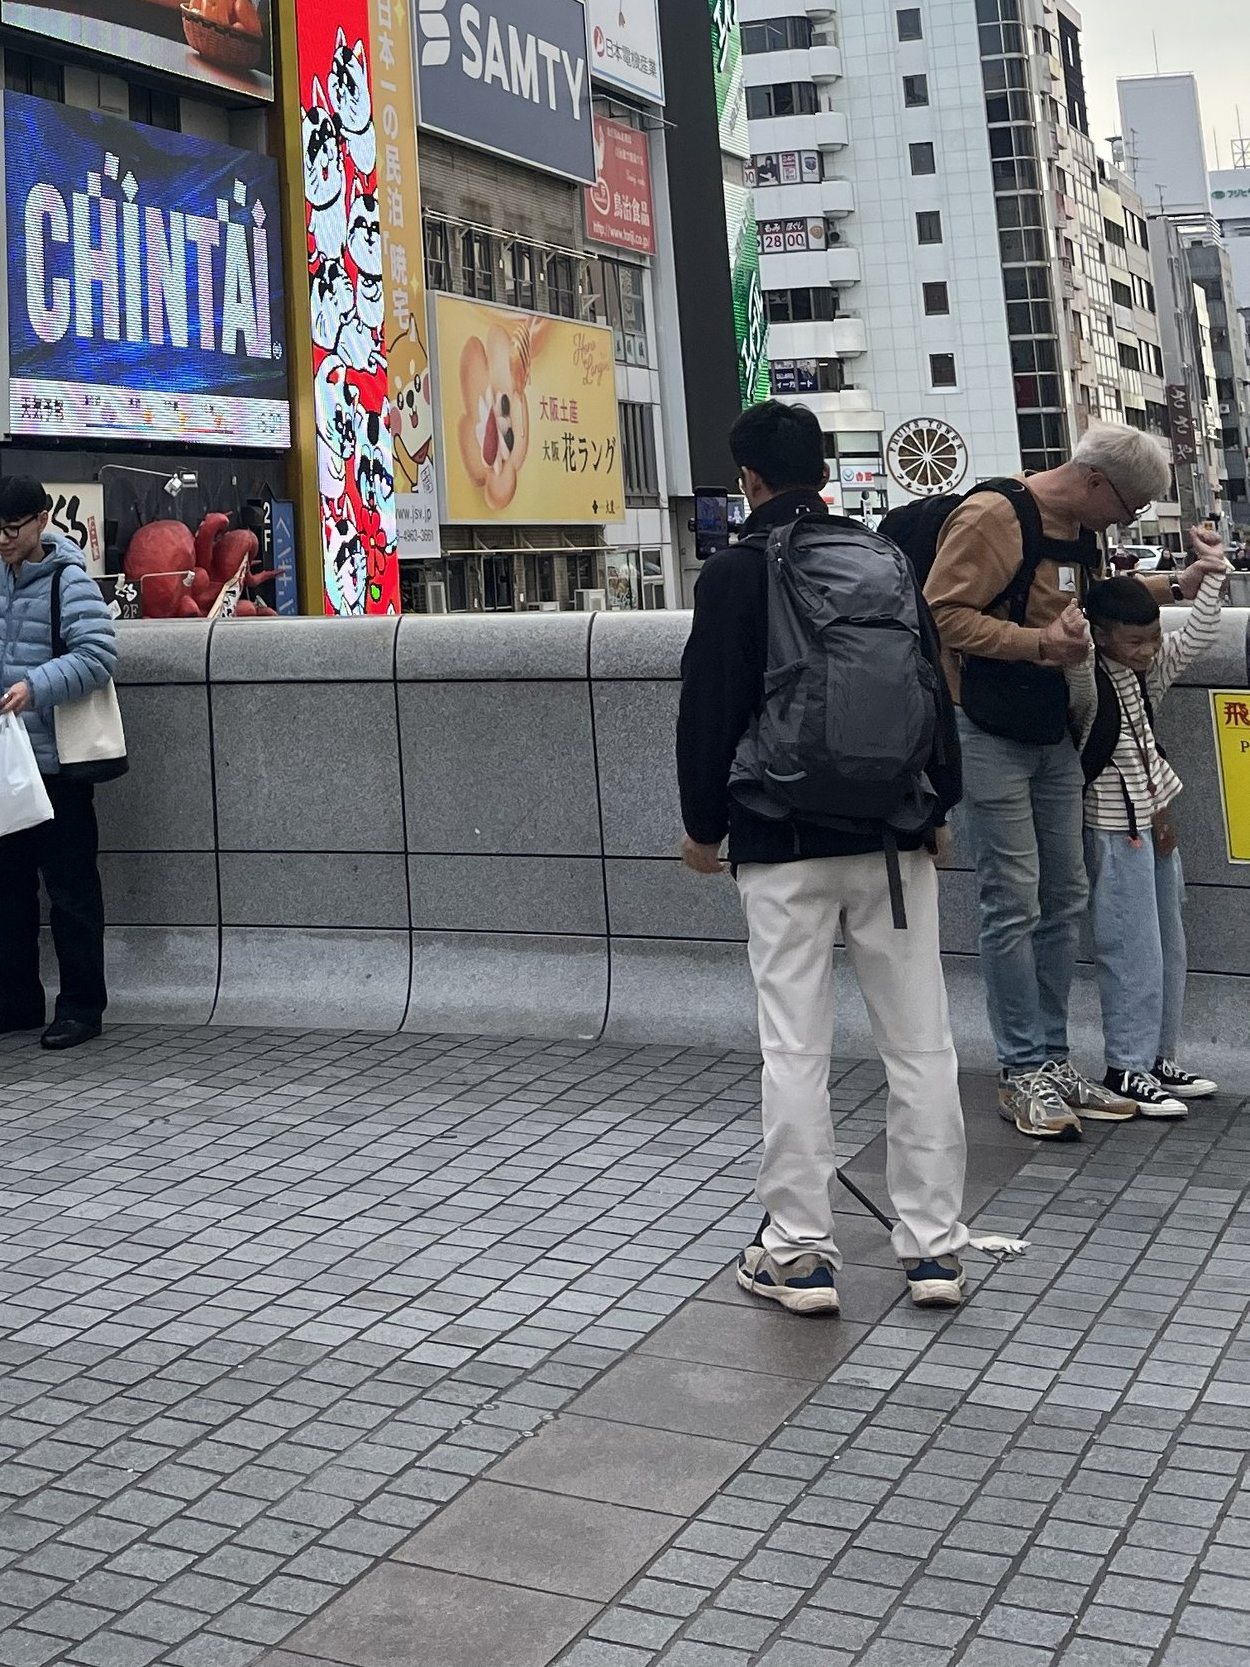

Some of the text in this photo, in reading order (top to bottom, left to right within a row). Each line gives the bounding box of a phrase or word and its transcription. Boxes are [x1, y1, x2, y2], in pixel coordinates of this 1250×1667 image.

[458, 2, 585, 121] SAMTY
[539, 394, 580, 425] 大阪土産
